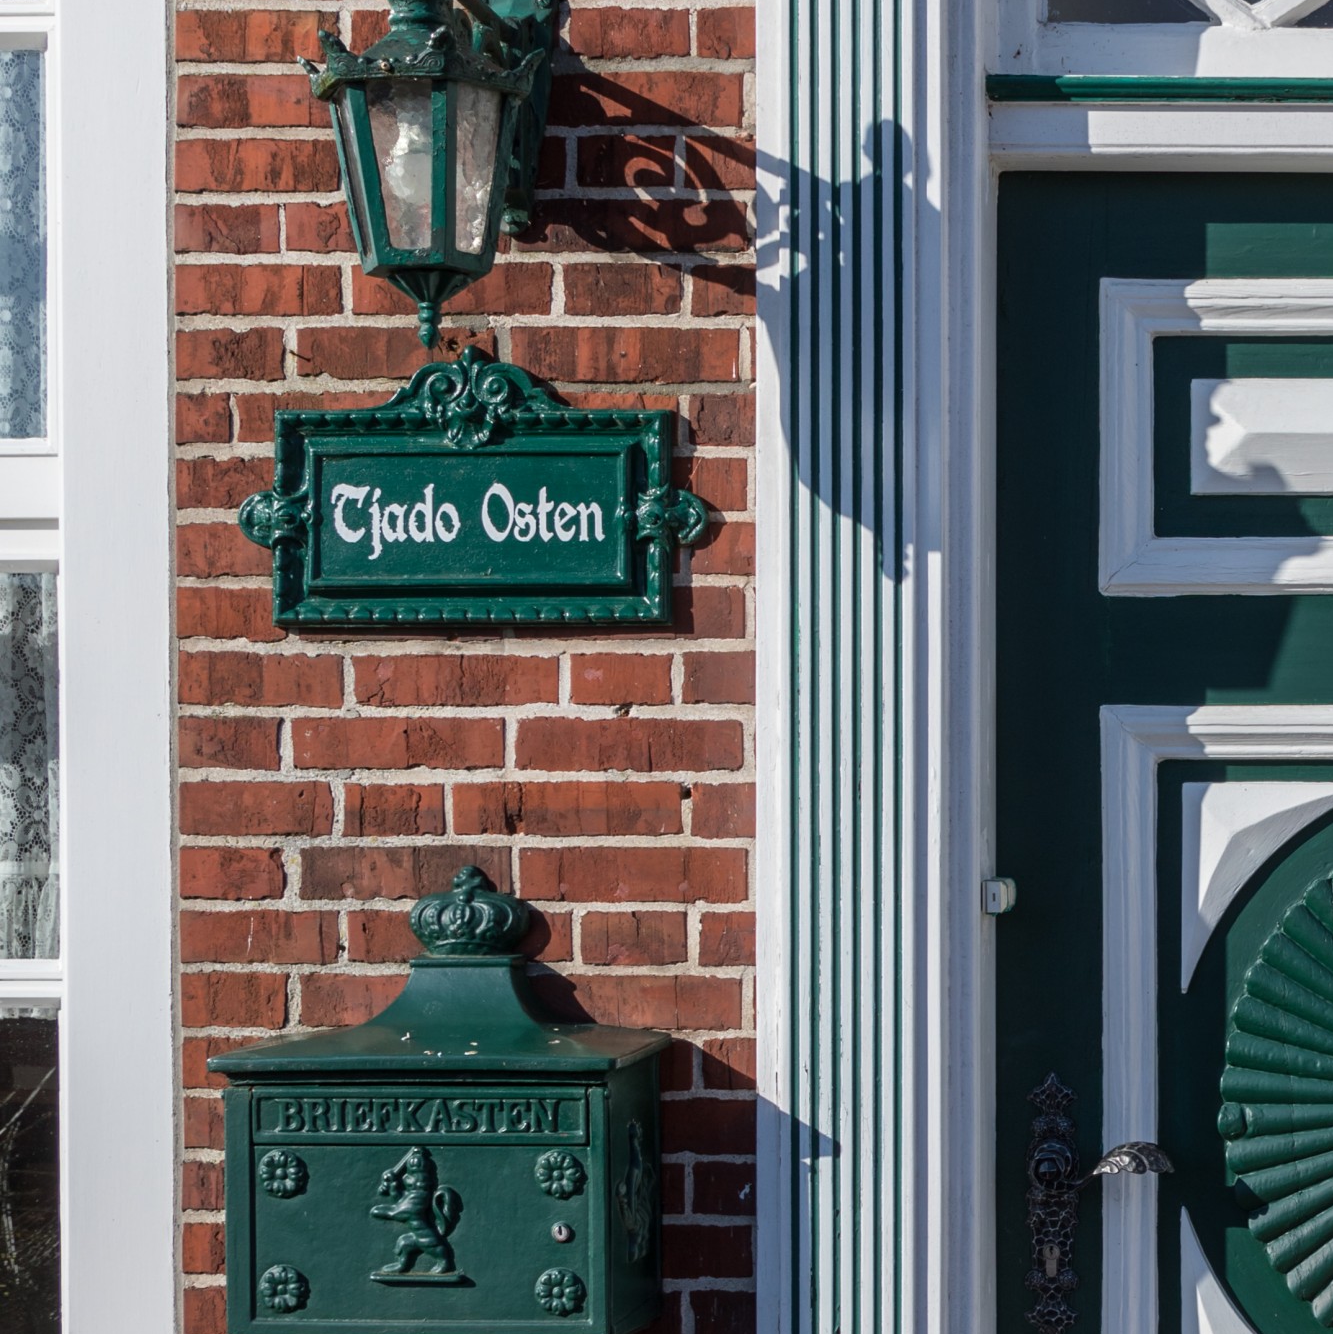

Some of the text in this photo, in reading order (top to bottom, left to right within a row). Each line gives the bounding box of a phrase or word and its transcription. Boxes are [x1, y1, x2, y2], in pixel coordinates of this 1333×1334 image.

[331, 483, 605, 560] Tjado Osten
[273, 1098, 561, 1134] BRIEFKASTEN
